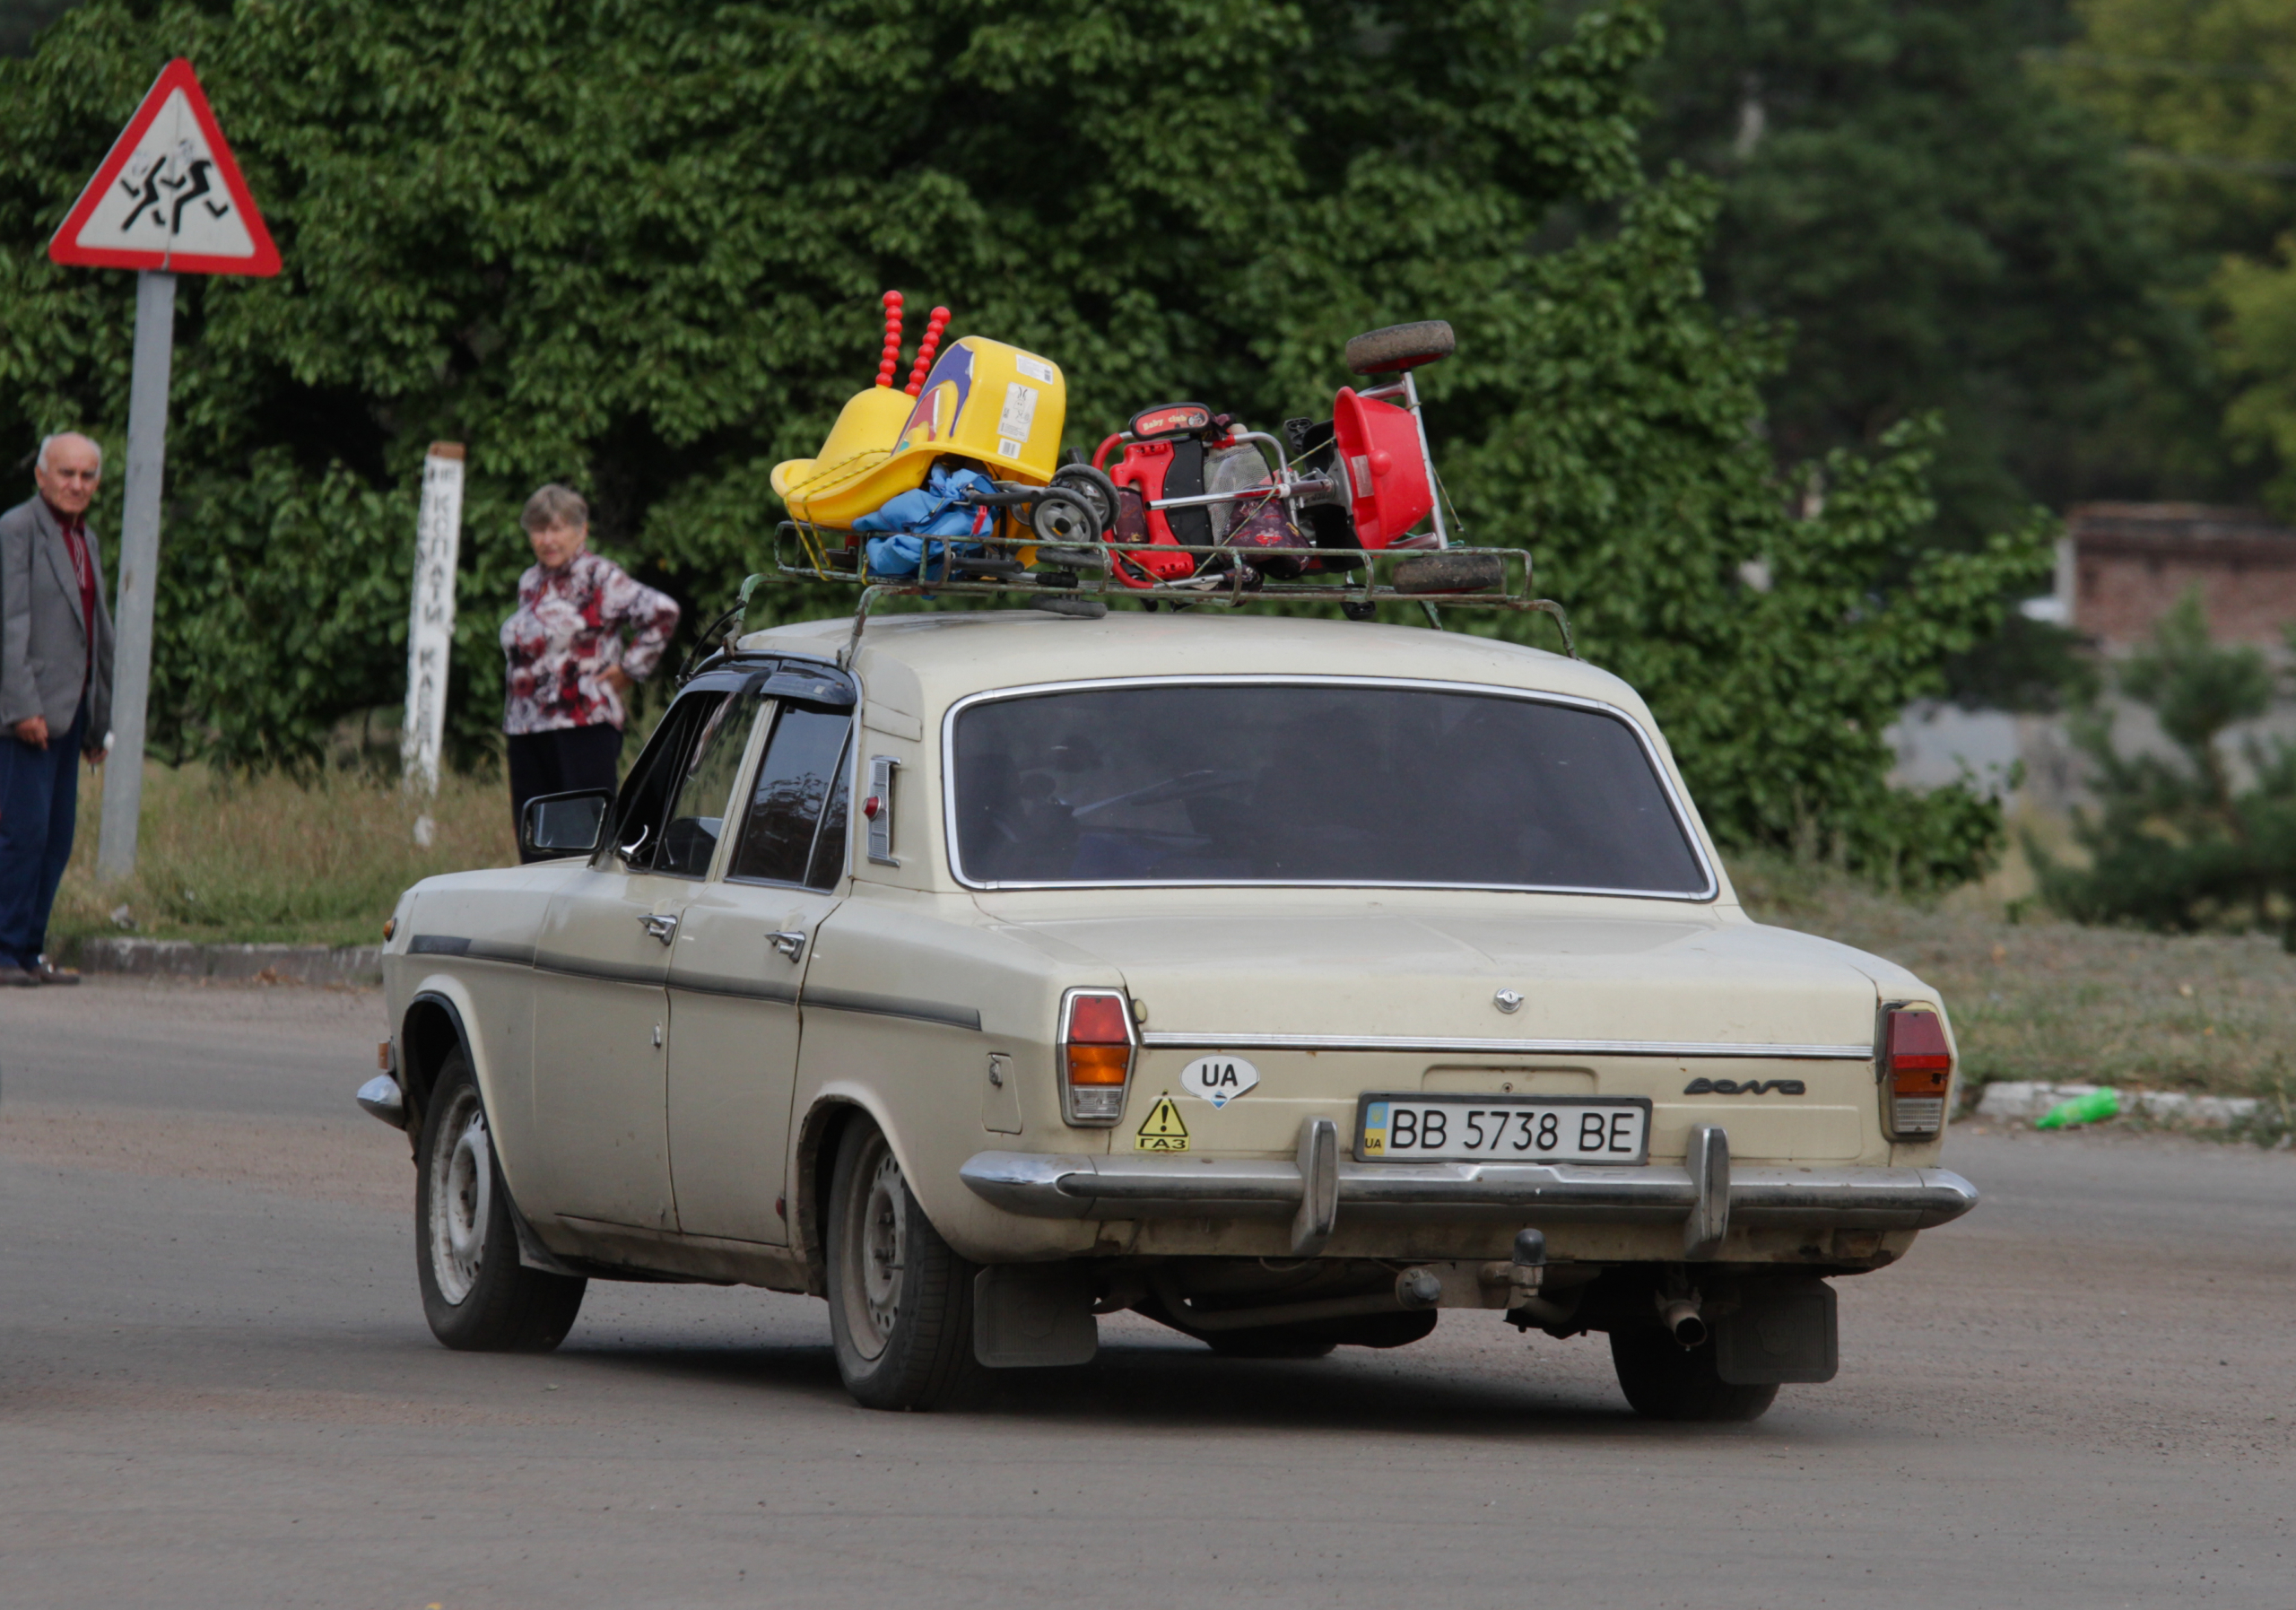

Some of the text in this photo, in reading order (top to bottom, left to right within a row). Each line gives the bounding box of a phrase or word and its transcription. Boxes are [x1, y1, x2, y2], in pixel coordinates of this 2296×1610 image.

[1143, 415, 1187, 431] Baby club
[1202, 1064, 1238, 1087] UA
[1390, 1109, 1634, 1153] BB 5738 BE
[1139, 1137, 1187, 1149] ГАЗ
[1364, 1137, 1382, 1149] UA
